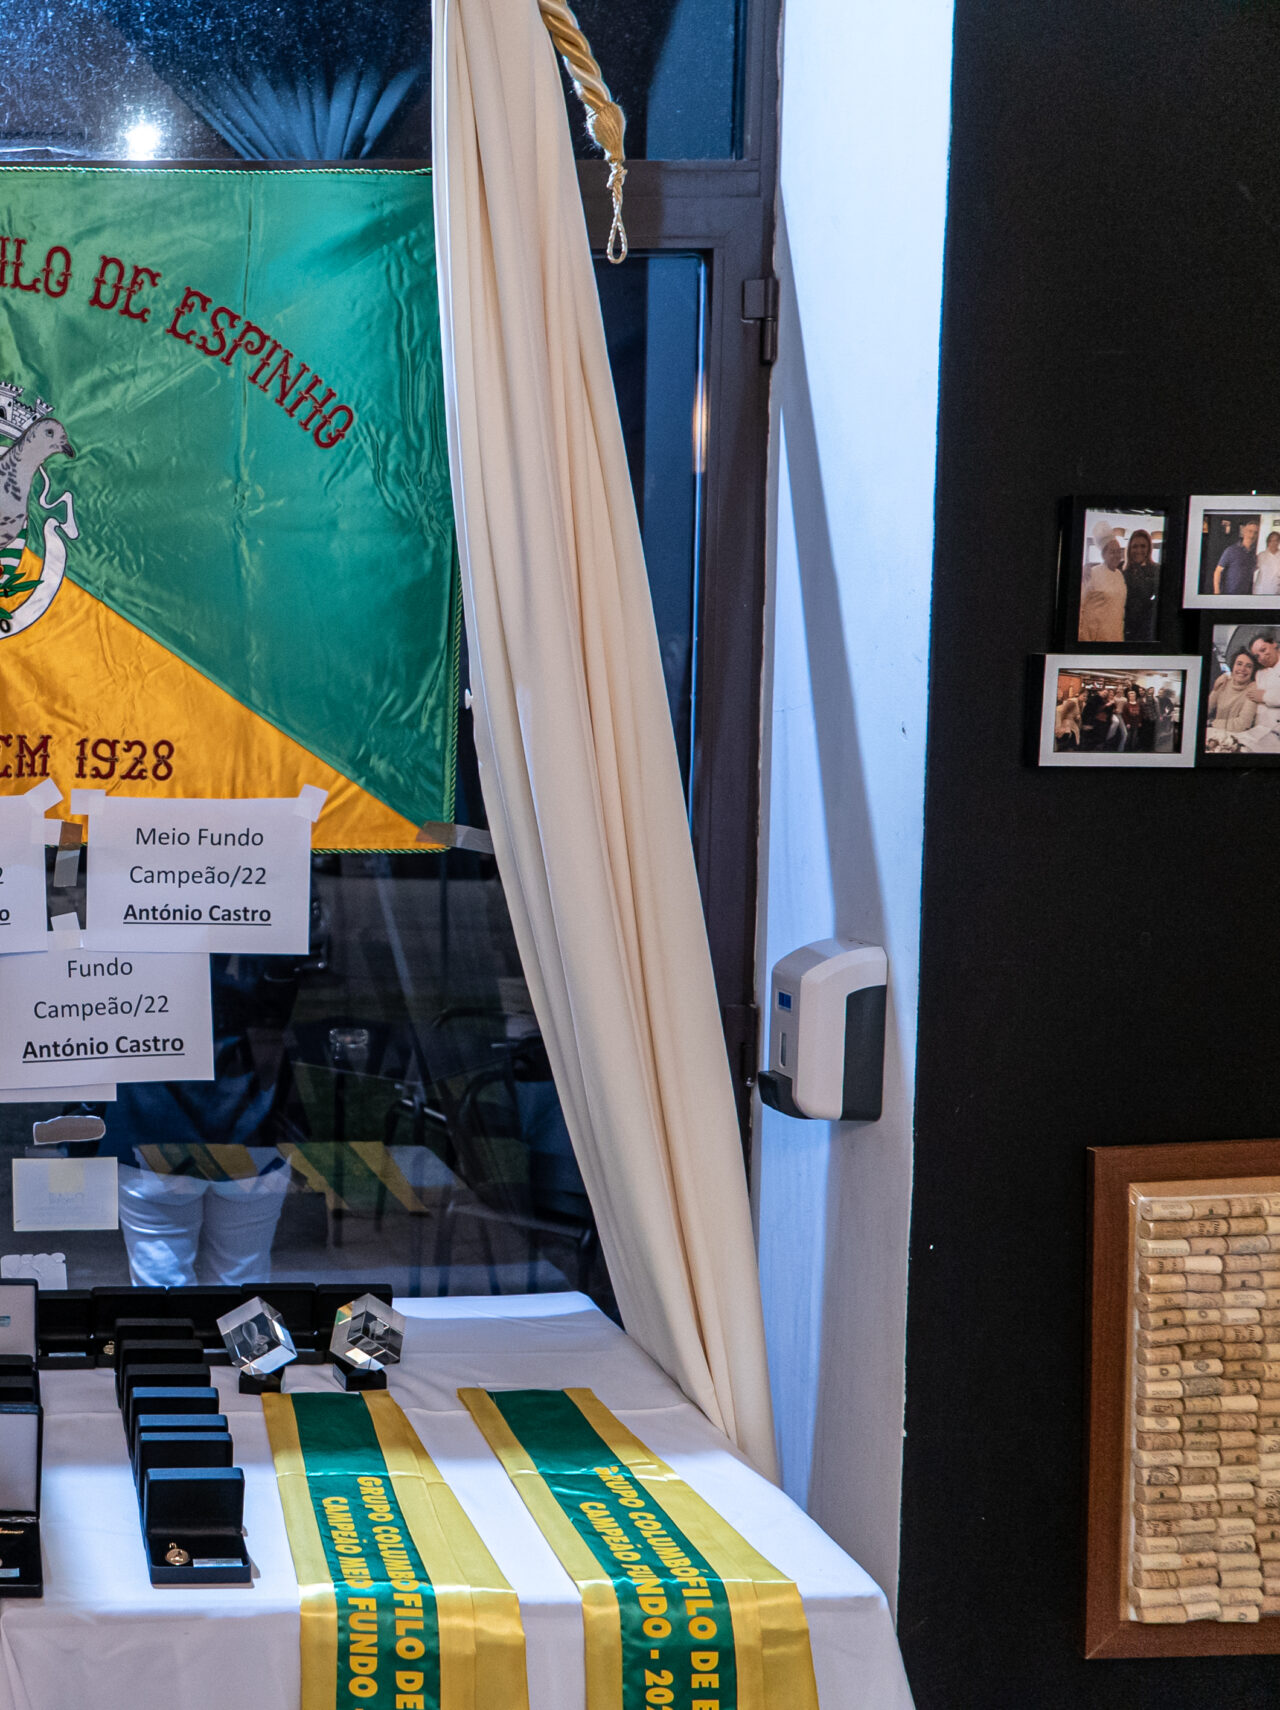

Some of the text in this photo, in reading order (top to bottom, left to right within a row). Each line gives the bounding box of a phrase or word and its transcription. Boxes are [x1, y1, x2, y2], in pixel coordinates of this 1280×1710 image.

[89, 256, 162, 324] DE
[174, 287, 355, 450] ESPINHO
[74, 738, 176, 782] 1928
[135, 827, 264, 846] Meio Fundo
[129, 865, 267, 889] Campeão/22
[123, 903, 272, 924] António Castro
[67, 957, 133, 978] Fundo
[33, 994, 169, 1021] Campeão/22
[22, 1035, 185, 1060] António Castro
[338, 1556, 374, 1589] MEIO
[593, 1466, 645, 1509] GRUPO
[628, 1512, 718, 1640] COLUMBÓFILO
[691, 1651, 719, 1688] DE
[357, 1476, 429, 1710] GRUPO COLUMBÓFILO DE
[621, 1564, 672, 1639] FUNDO
[348, 1597, 378, 1698] FUNDO
